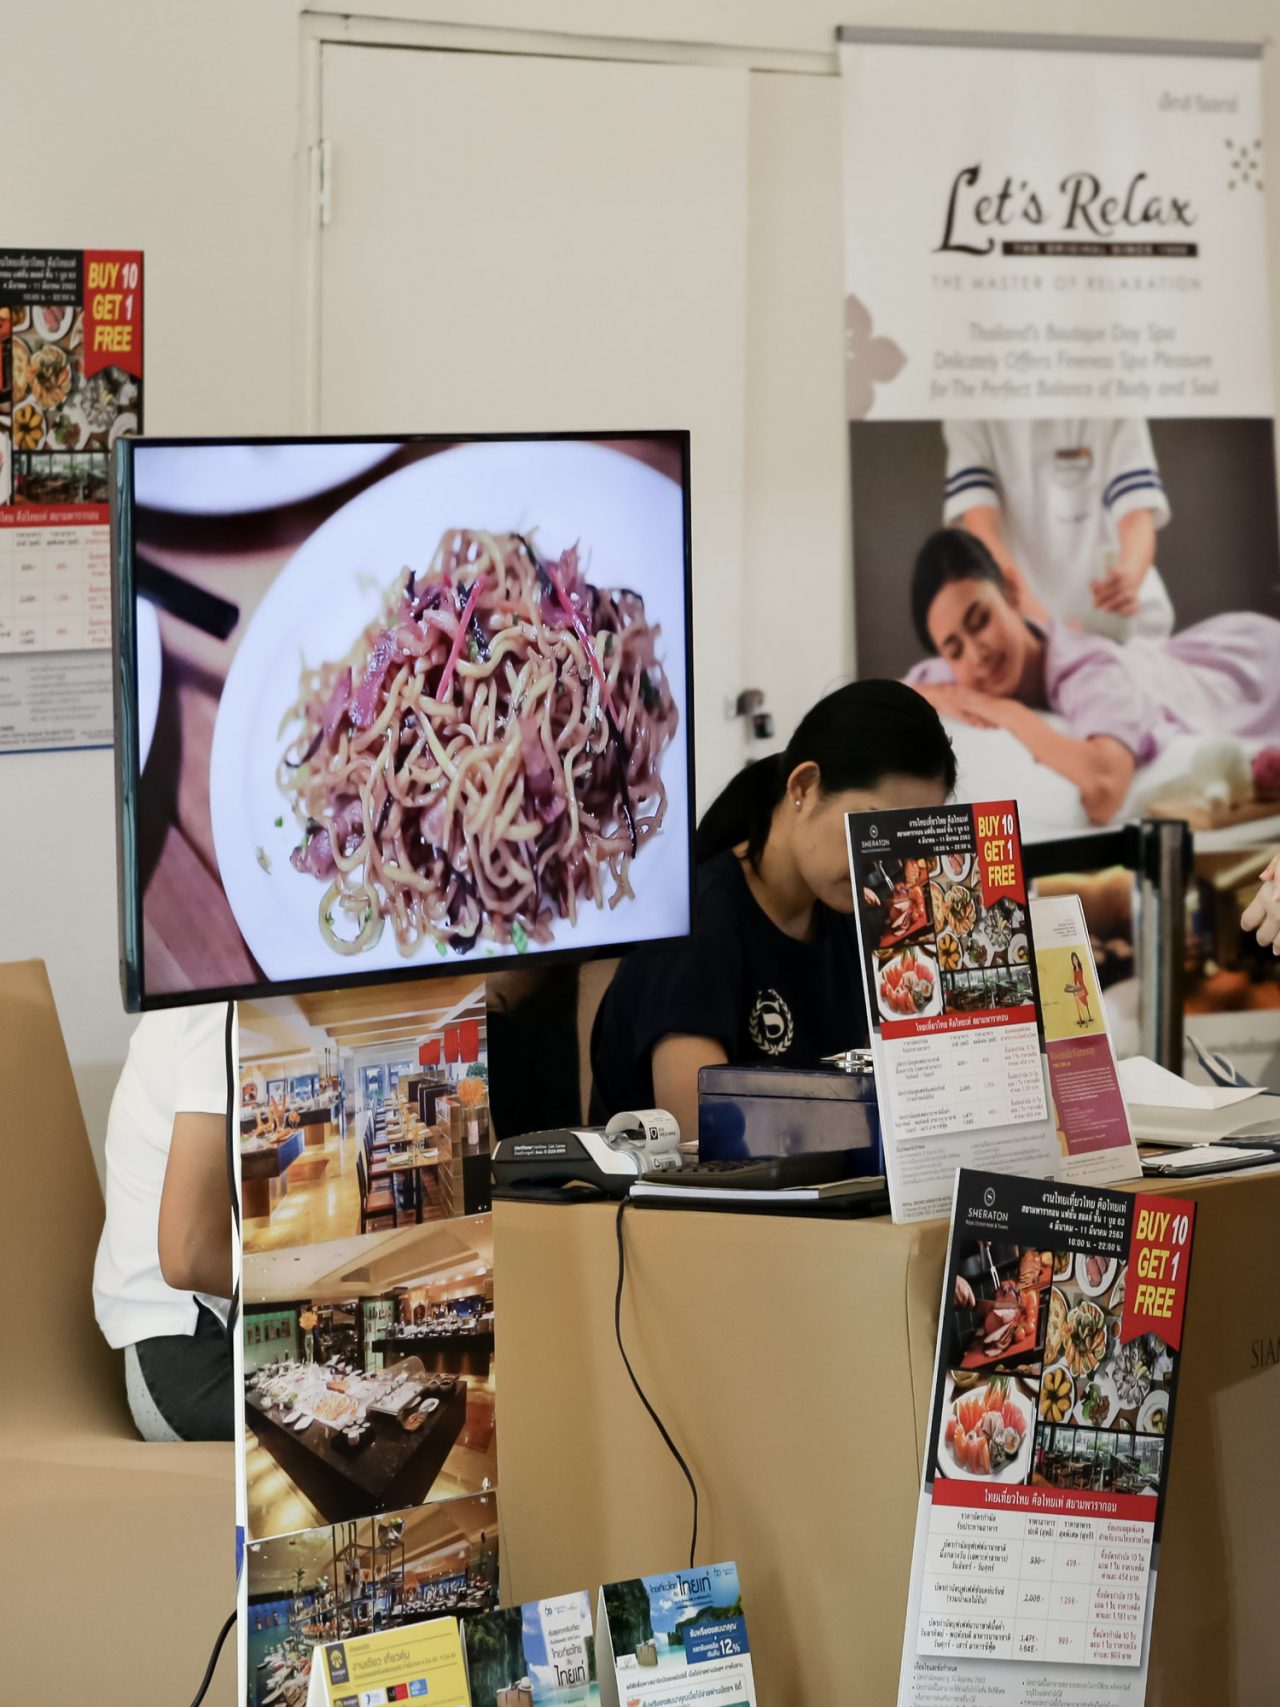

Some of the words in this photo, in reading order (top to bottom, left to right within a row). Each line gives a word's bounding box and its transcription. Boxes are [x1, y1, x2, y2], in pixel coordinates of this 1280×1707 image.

[932, 163, 1044, 256] Let's
[1059, 172, 1196, 237] Relax
[87, 262, 120, 289] BUY
[122, 262, 138, 289] 10
[932, 274, 962, 291] THE
[972, 275, 1042, 291] MASTER
[1054, 276, 1078, 291] OF
[1087, 276, 1203, 292] RELAXATION
[92, 294, 123, 320] GET
[125, 294, 134, 321] 1
[94, 325, 132, 352] FREE
[978, 815, 1000, 837] BUY
[1002, 814, 1013, 835] 10
[862, 839, 890, 848] SHERATON
[984, 840, 1005, 862] GET
[1007, 839, 1013, 860] 1
[988, 865, 1015, 887] FREE
[1041, 1191, 1096, 1209] งานไทยเที่ยวไทย
[968, 1207, 1009, 1222] SHERATON
[1021, 1205, 1060, 1218] สยามพารากอน
[1117, 1218, 1125, 1226] 63
[1054, 1221, 1073, 1233] มีนาคม
[1080, 1226, 1087, 1235] 11
[1088, 1226, 1107, 1237] มีนาคม
[1108, 1230, 1124, 1239] 2563
[1136, 1210, 1171, 1243] BUY
[1172, 1214, 1189, 1246] 10
[1068, 1237, 1085, 1247] 10:00
[1098, 1241, 1116, 1251] 22:00
[1137, 1247, 1170, 1280] GET
[1171, 1252, 1180, 1281] 1
[1134, 1285, 1176, 1318] FREE
[985, 1487, 1030, 1505] ไทยเที่ยวไทย
[1032, 1491, 1064, 1509] คือไทยเท่
[1066, 1495, 1117, 1513] สยามพารากอน
